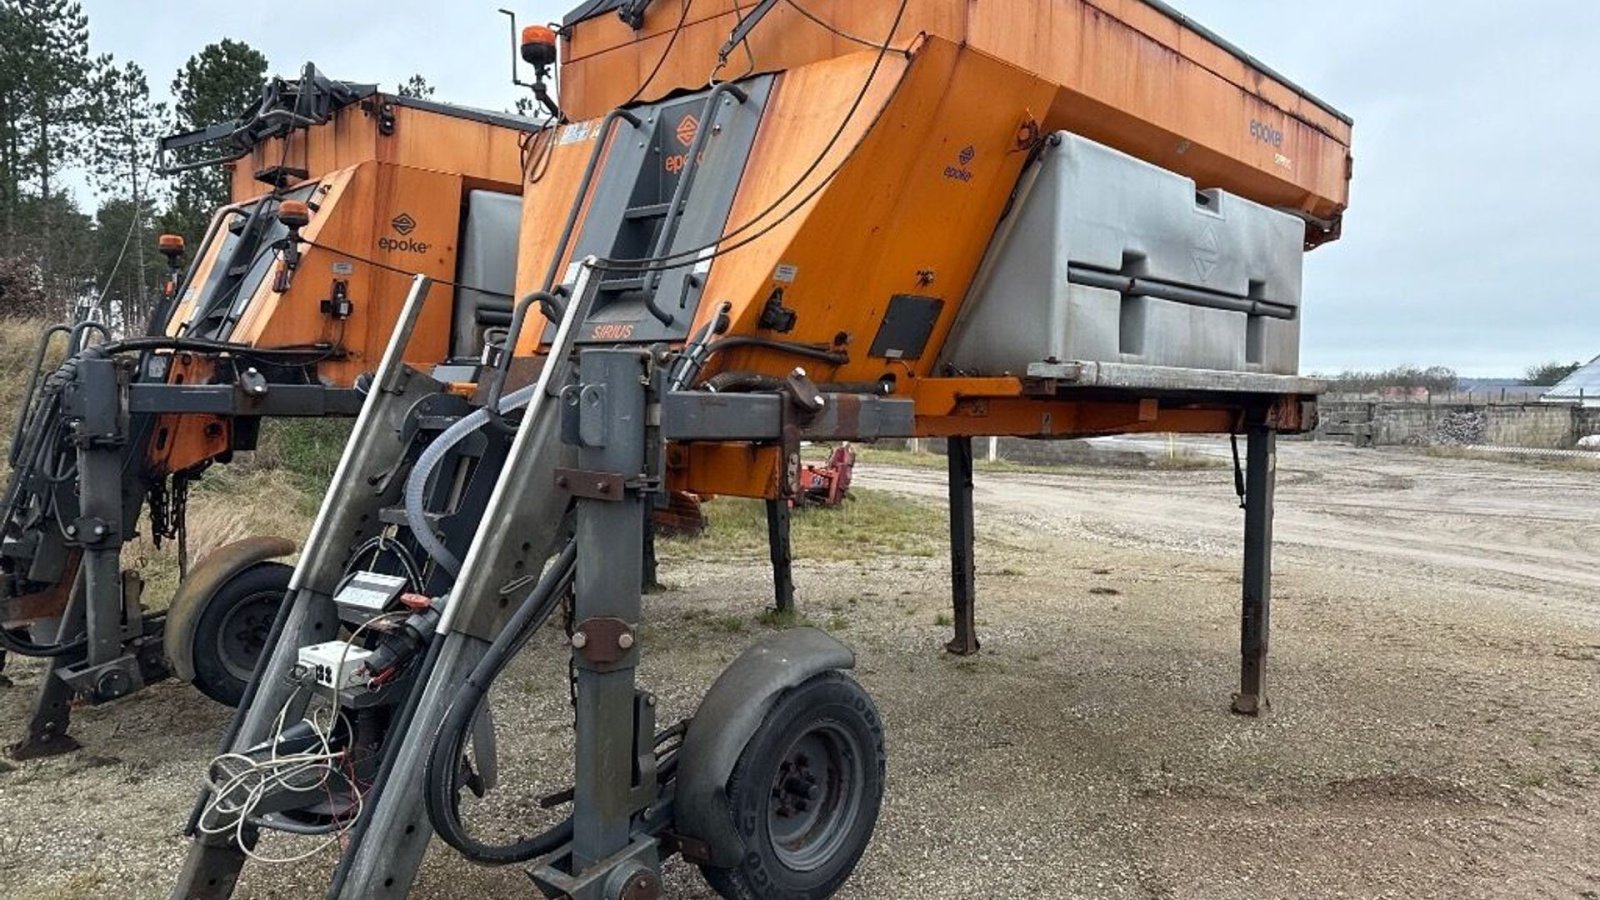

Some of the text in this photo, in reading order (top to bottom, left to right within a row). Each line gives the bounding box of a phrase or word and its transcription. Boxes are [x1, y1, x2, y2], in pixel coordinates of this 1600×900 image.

[1250, 119, 1281, 147] epoke
[944, 166, 971, 182] epoke
[379, 237, 427, 254] epoke
[592, 324, 634, 339] SIRIUS
